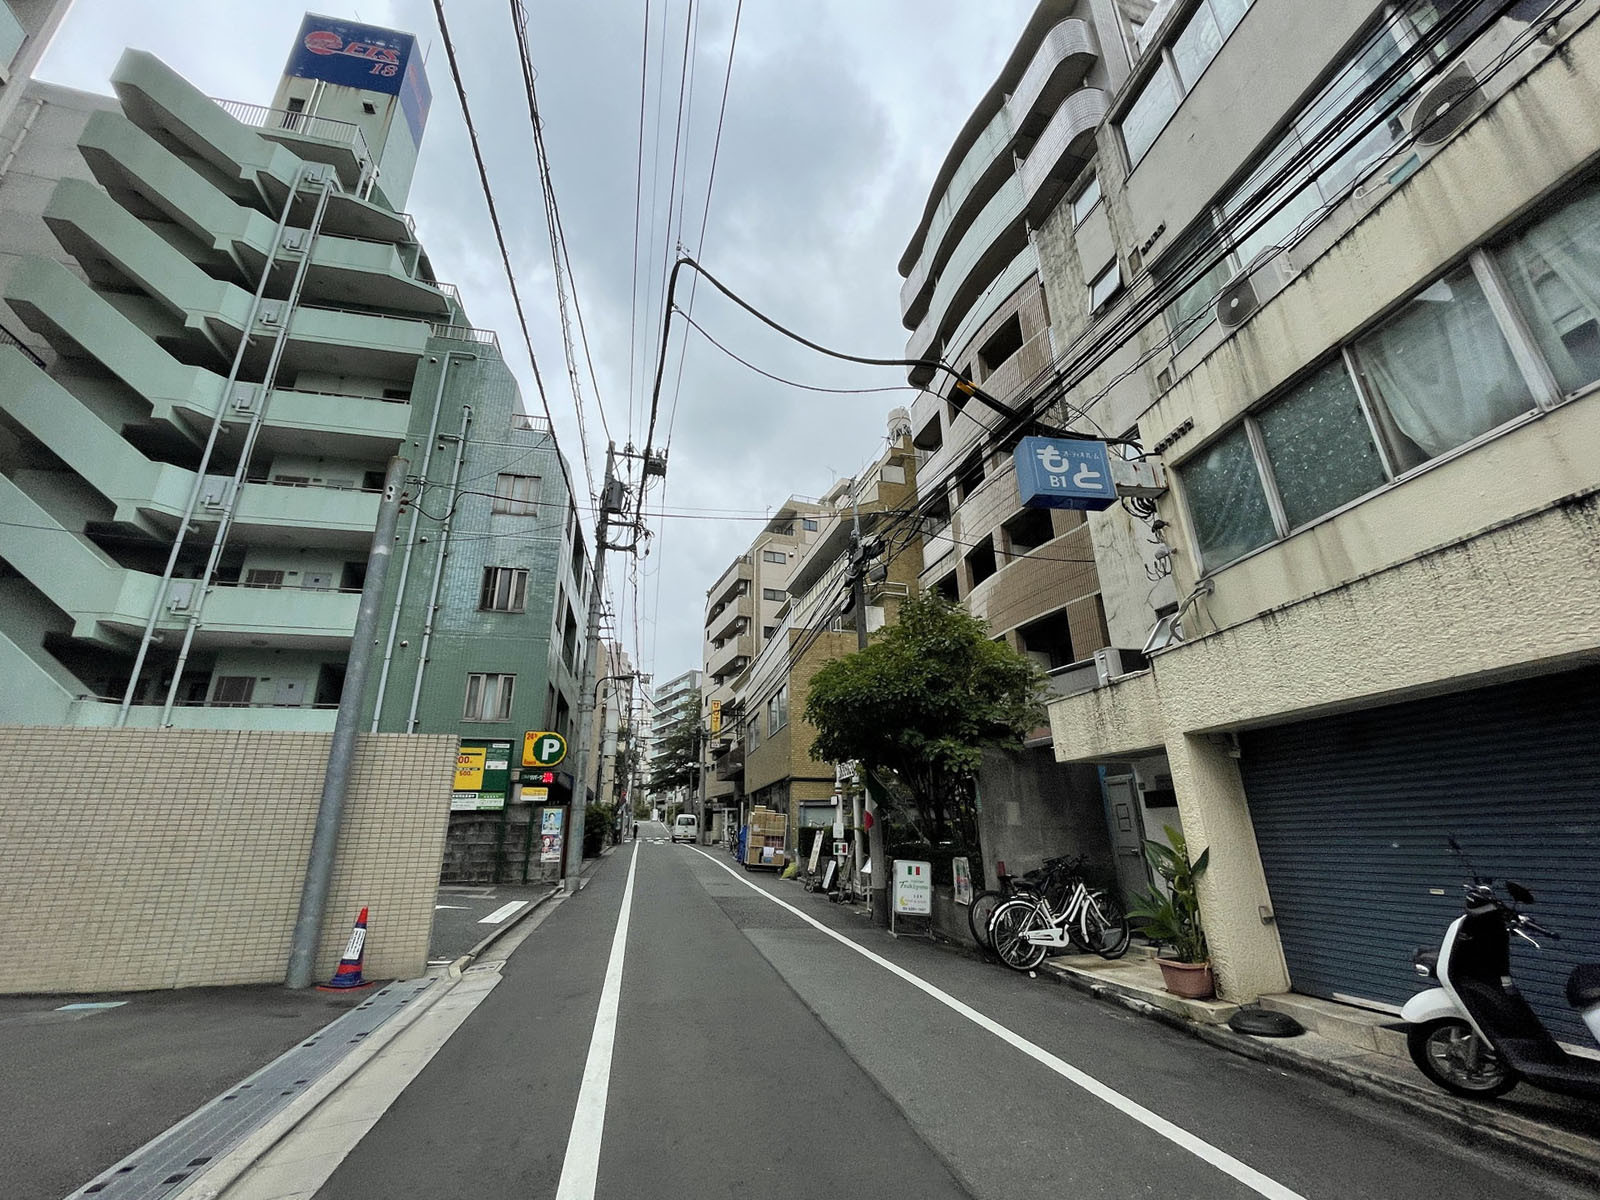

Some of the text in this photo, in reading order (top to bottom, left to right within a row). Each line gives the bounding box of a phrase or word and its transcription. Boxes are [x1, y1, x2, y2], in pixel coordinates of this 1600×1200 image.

[369, 63, 398, 77] 18
[1049, 475, 1067, 487] B1
[542, 739, 560, 760] P
